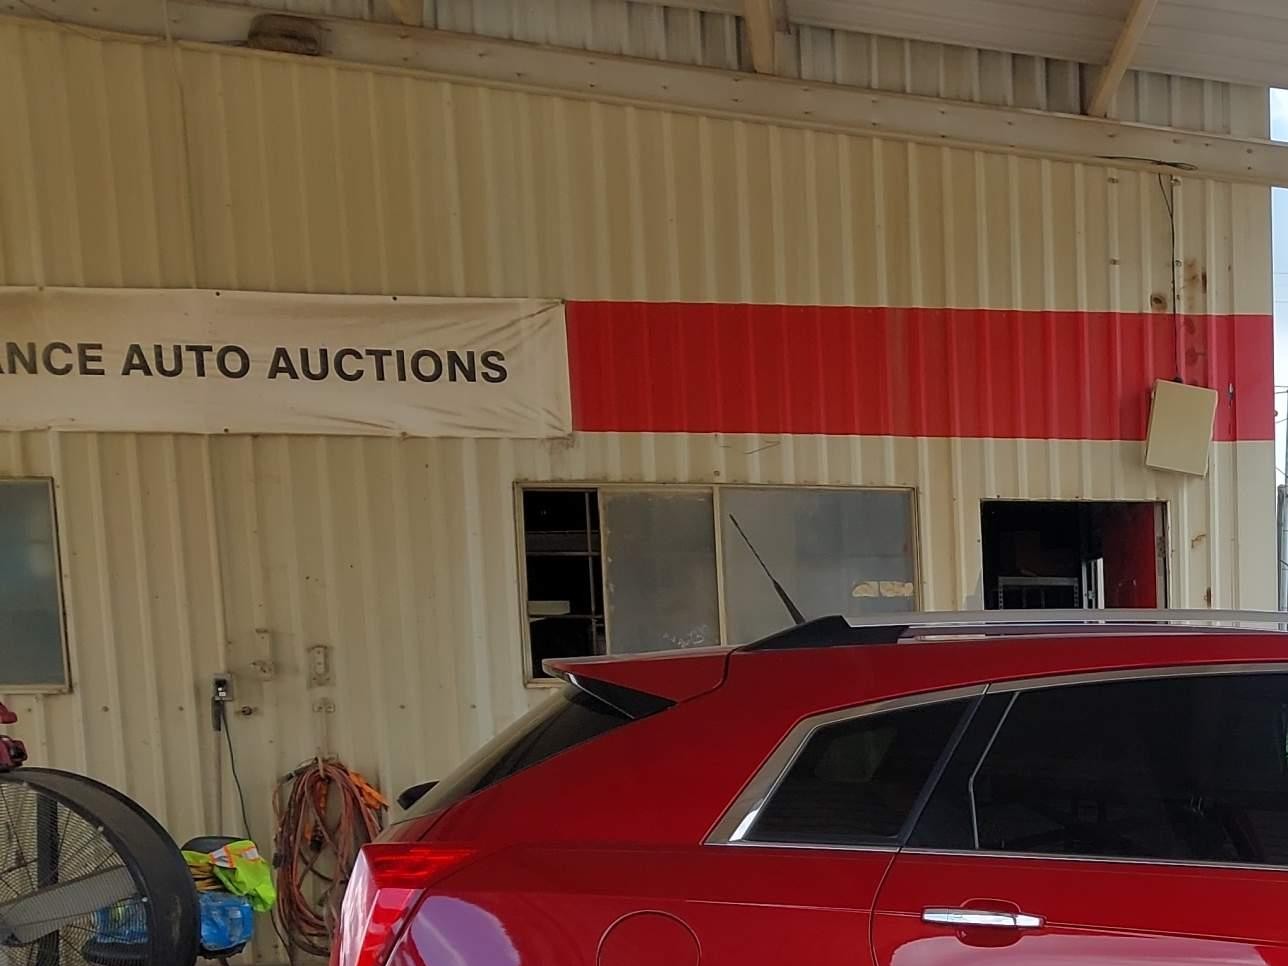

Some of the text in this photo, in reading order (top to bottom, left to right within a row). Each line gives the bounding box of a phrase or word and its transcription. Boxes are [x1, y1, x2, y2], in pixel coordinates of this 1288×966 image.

[0, 341, 509, 384] NCE AUTO AUCTIONS
